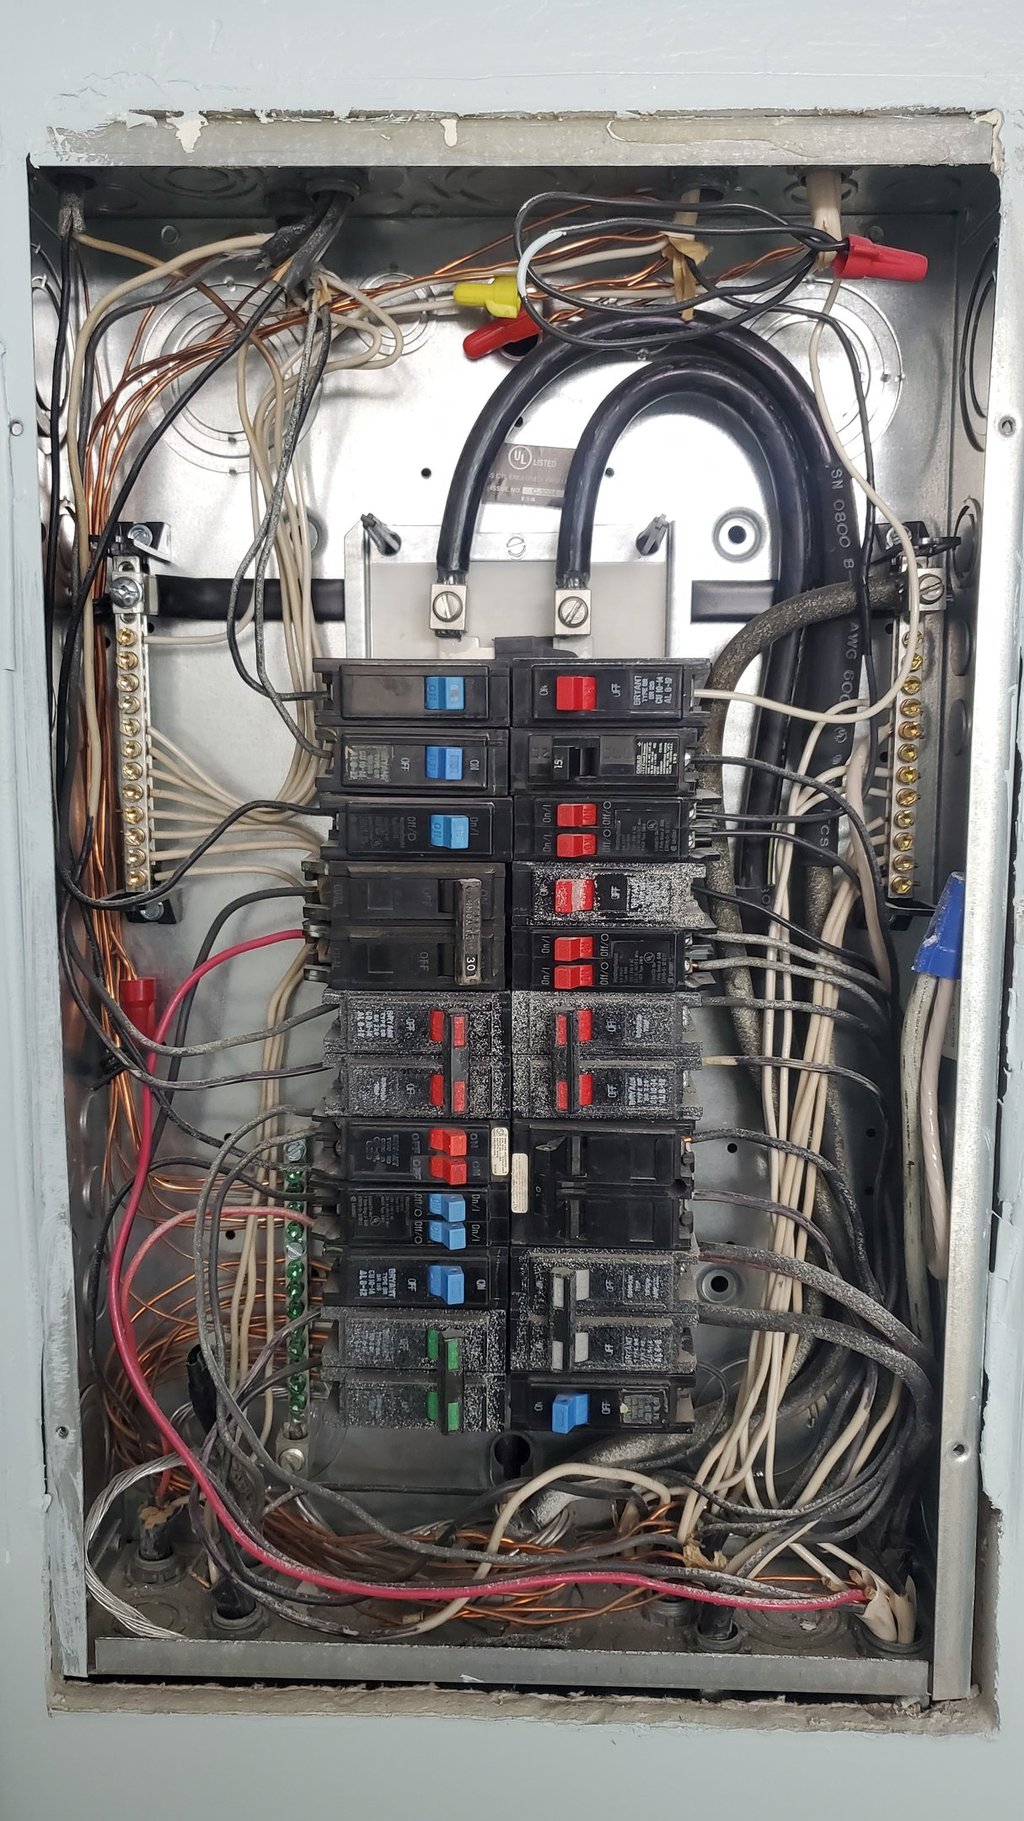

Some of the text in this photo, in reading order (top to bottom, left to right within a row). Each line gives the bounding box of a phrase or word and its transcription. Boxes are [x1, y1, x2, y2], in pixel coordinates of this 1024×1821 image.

[514, 449, 557, 468] UL LISTED
[845, 622, 859, 660] AWG
[634, 675, 642, 706] BRYANT
[655, 694, 663, 704] CU
[665, 694, 672, 704] AL
[400, 758, 410, 772] OFF
[470, 760, 479, 770] ON
[554, 759, 563, 769] 15
[611, 886, 620, 900] OFF
[419, 951, 429, 971] OFF
[466, 957, 475, 972] 30
[607, 1084, 617, 1098] OFF
[469, 1133, 479, 1148] ON
[472, 1161, 481, 1177] ON
[359, 1269, 368, 1280] AL
[368, 1269, 375, 1278] CU
[388, 1268, 396, 1298] BRYANT
[407, 1278, 417, 1292] OFF
[476, 1279, 486, 1290] ON
[534, 1401, 543, 1412] ON
[601, 1401, 611, 1415] OFF
